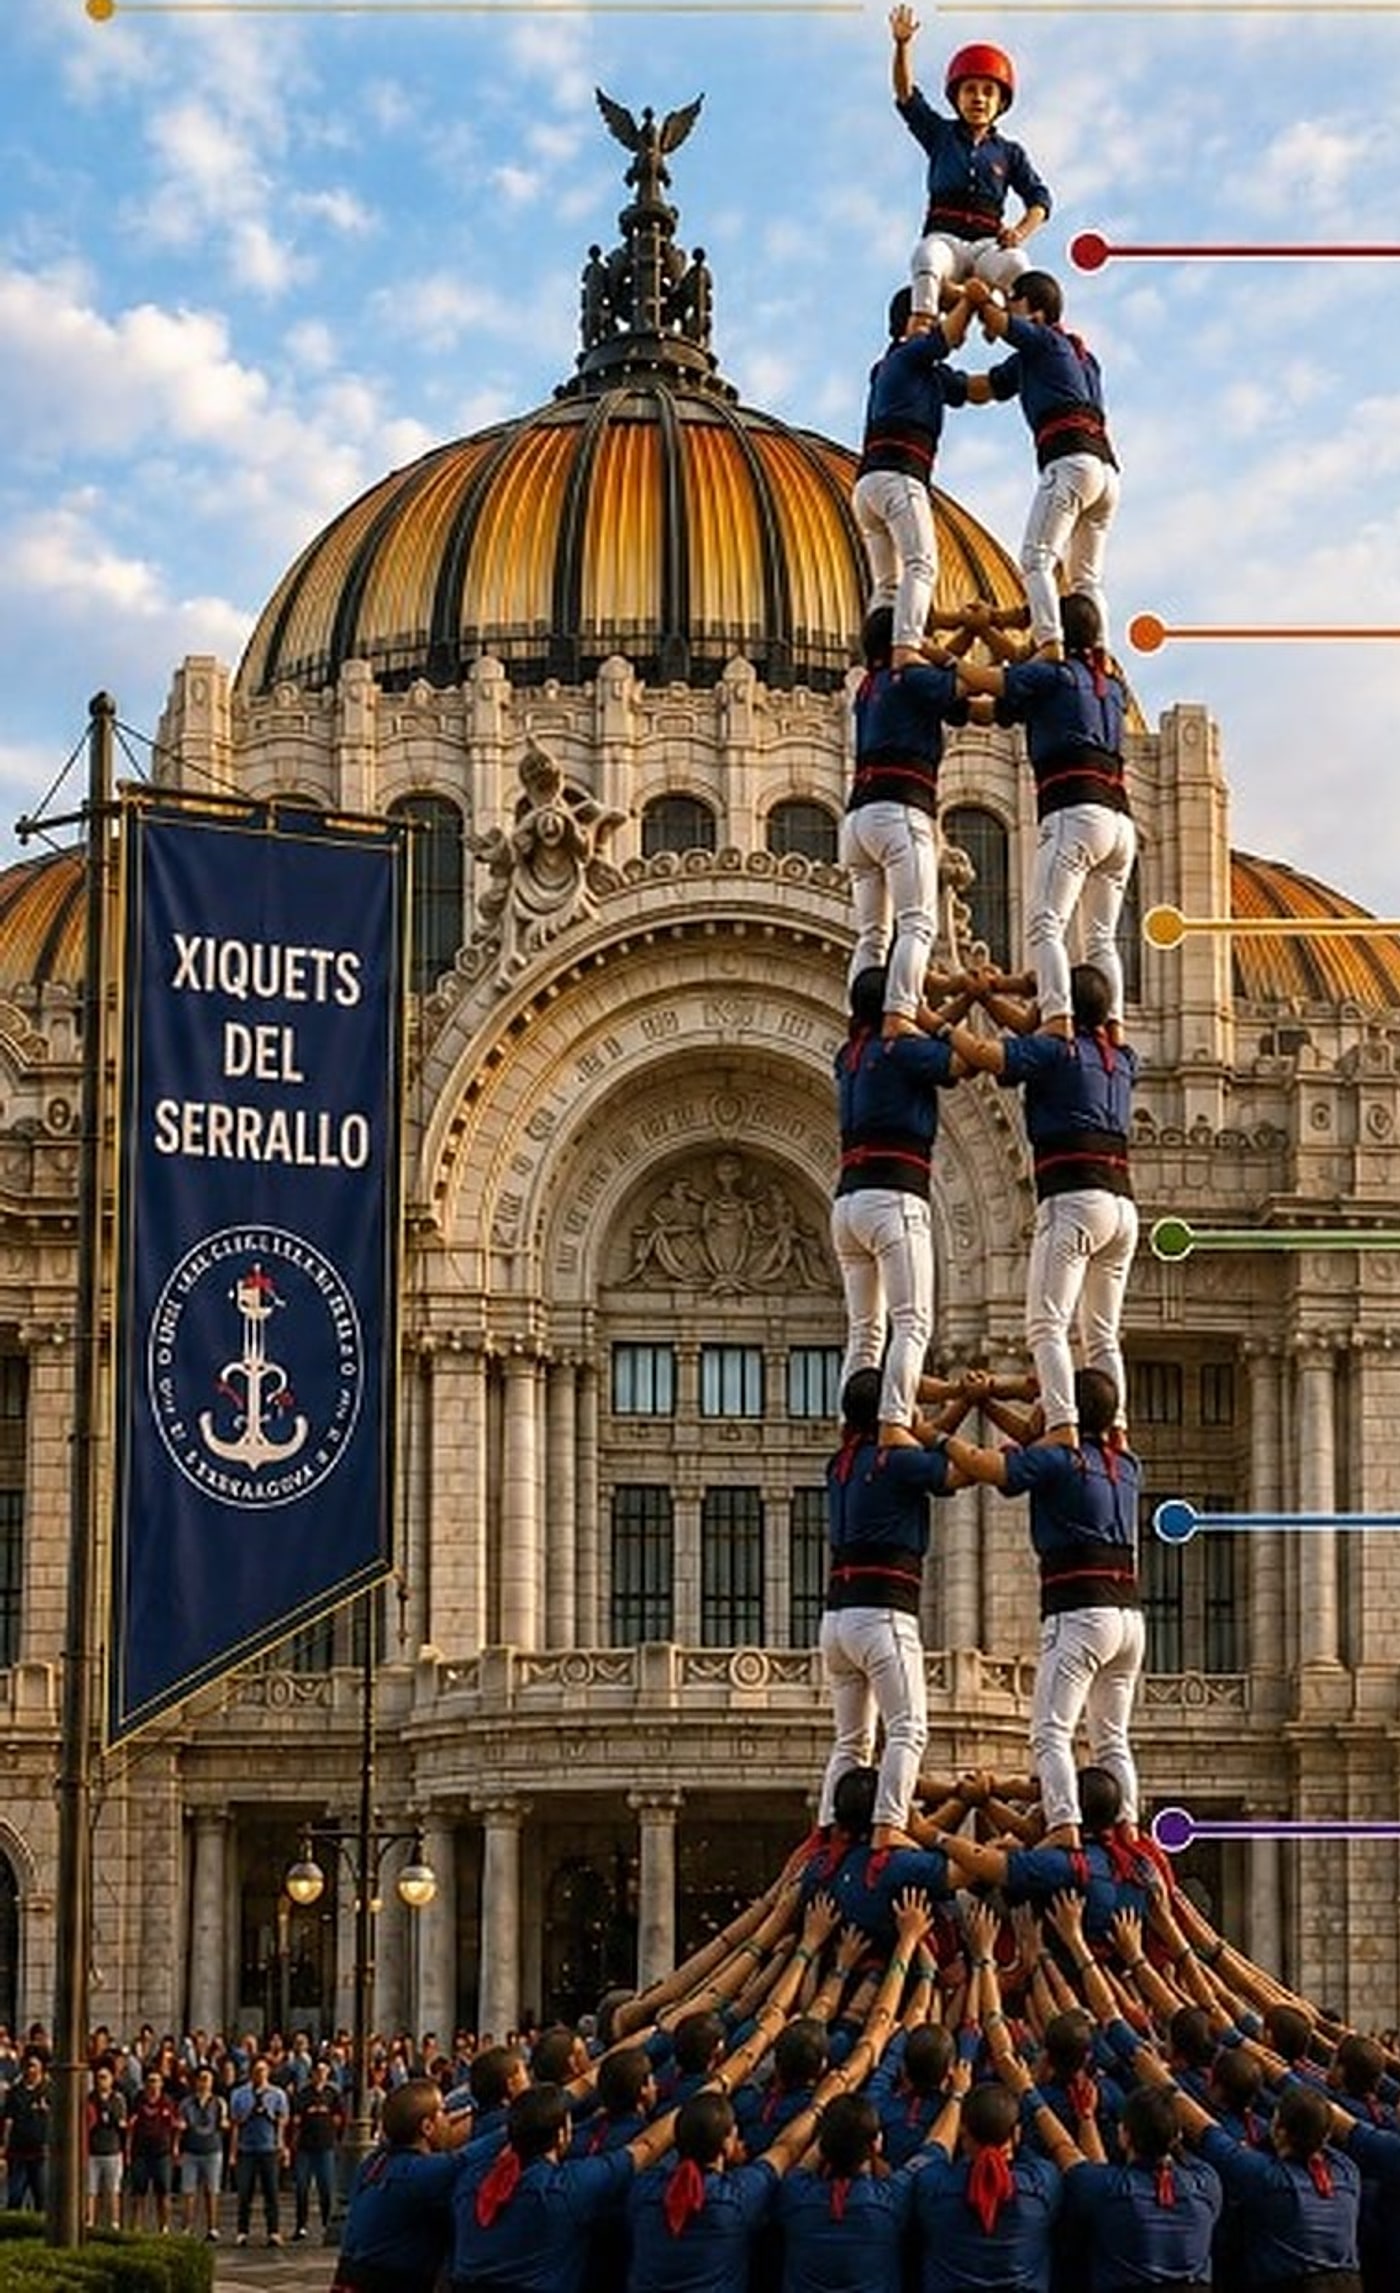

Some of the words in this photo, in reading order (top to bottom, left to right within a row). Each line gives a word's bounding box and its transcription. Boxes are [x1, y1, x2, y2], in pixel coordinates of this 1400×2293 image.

[173, 934, 361, 1006] XIQUETS
[225, 1022, 303, 1081] DEL
[155, 1100, 368, 1168] SERRALLO
